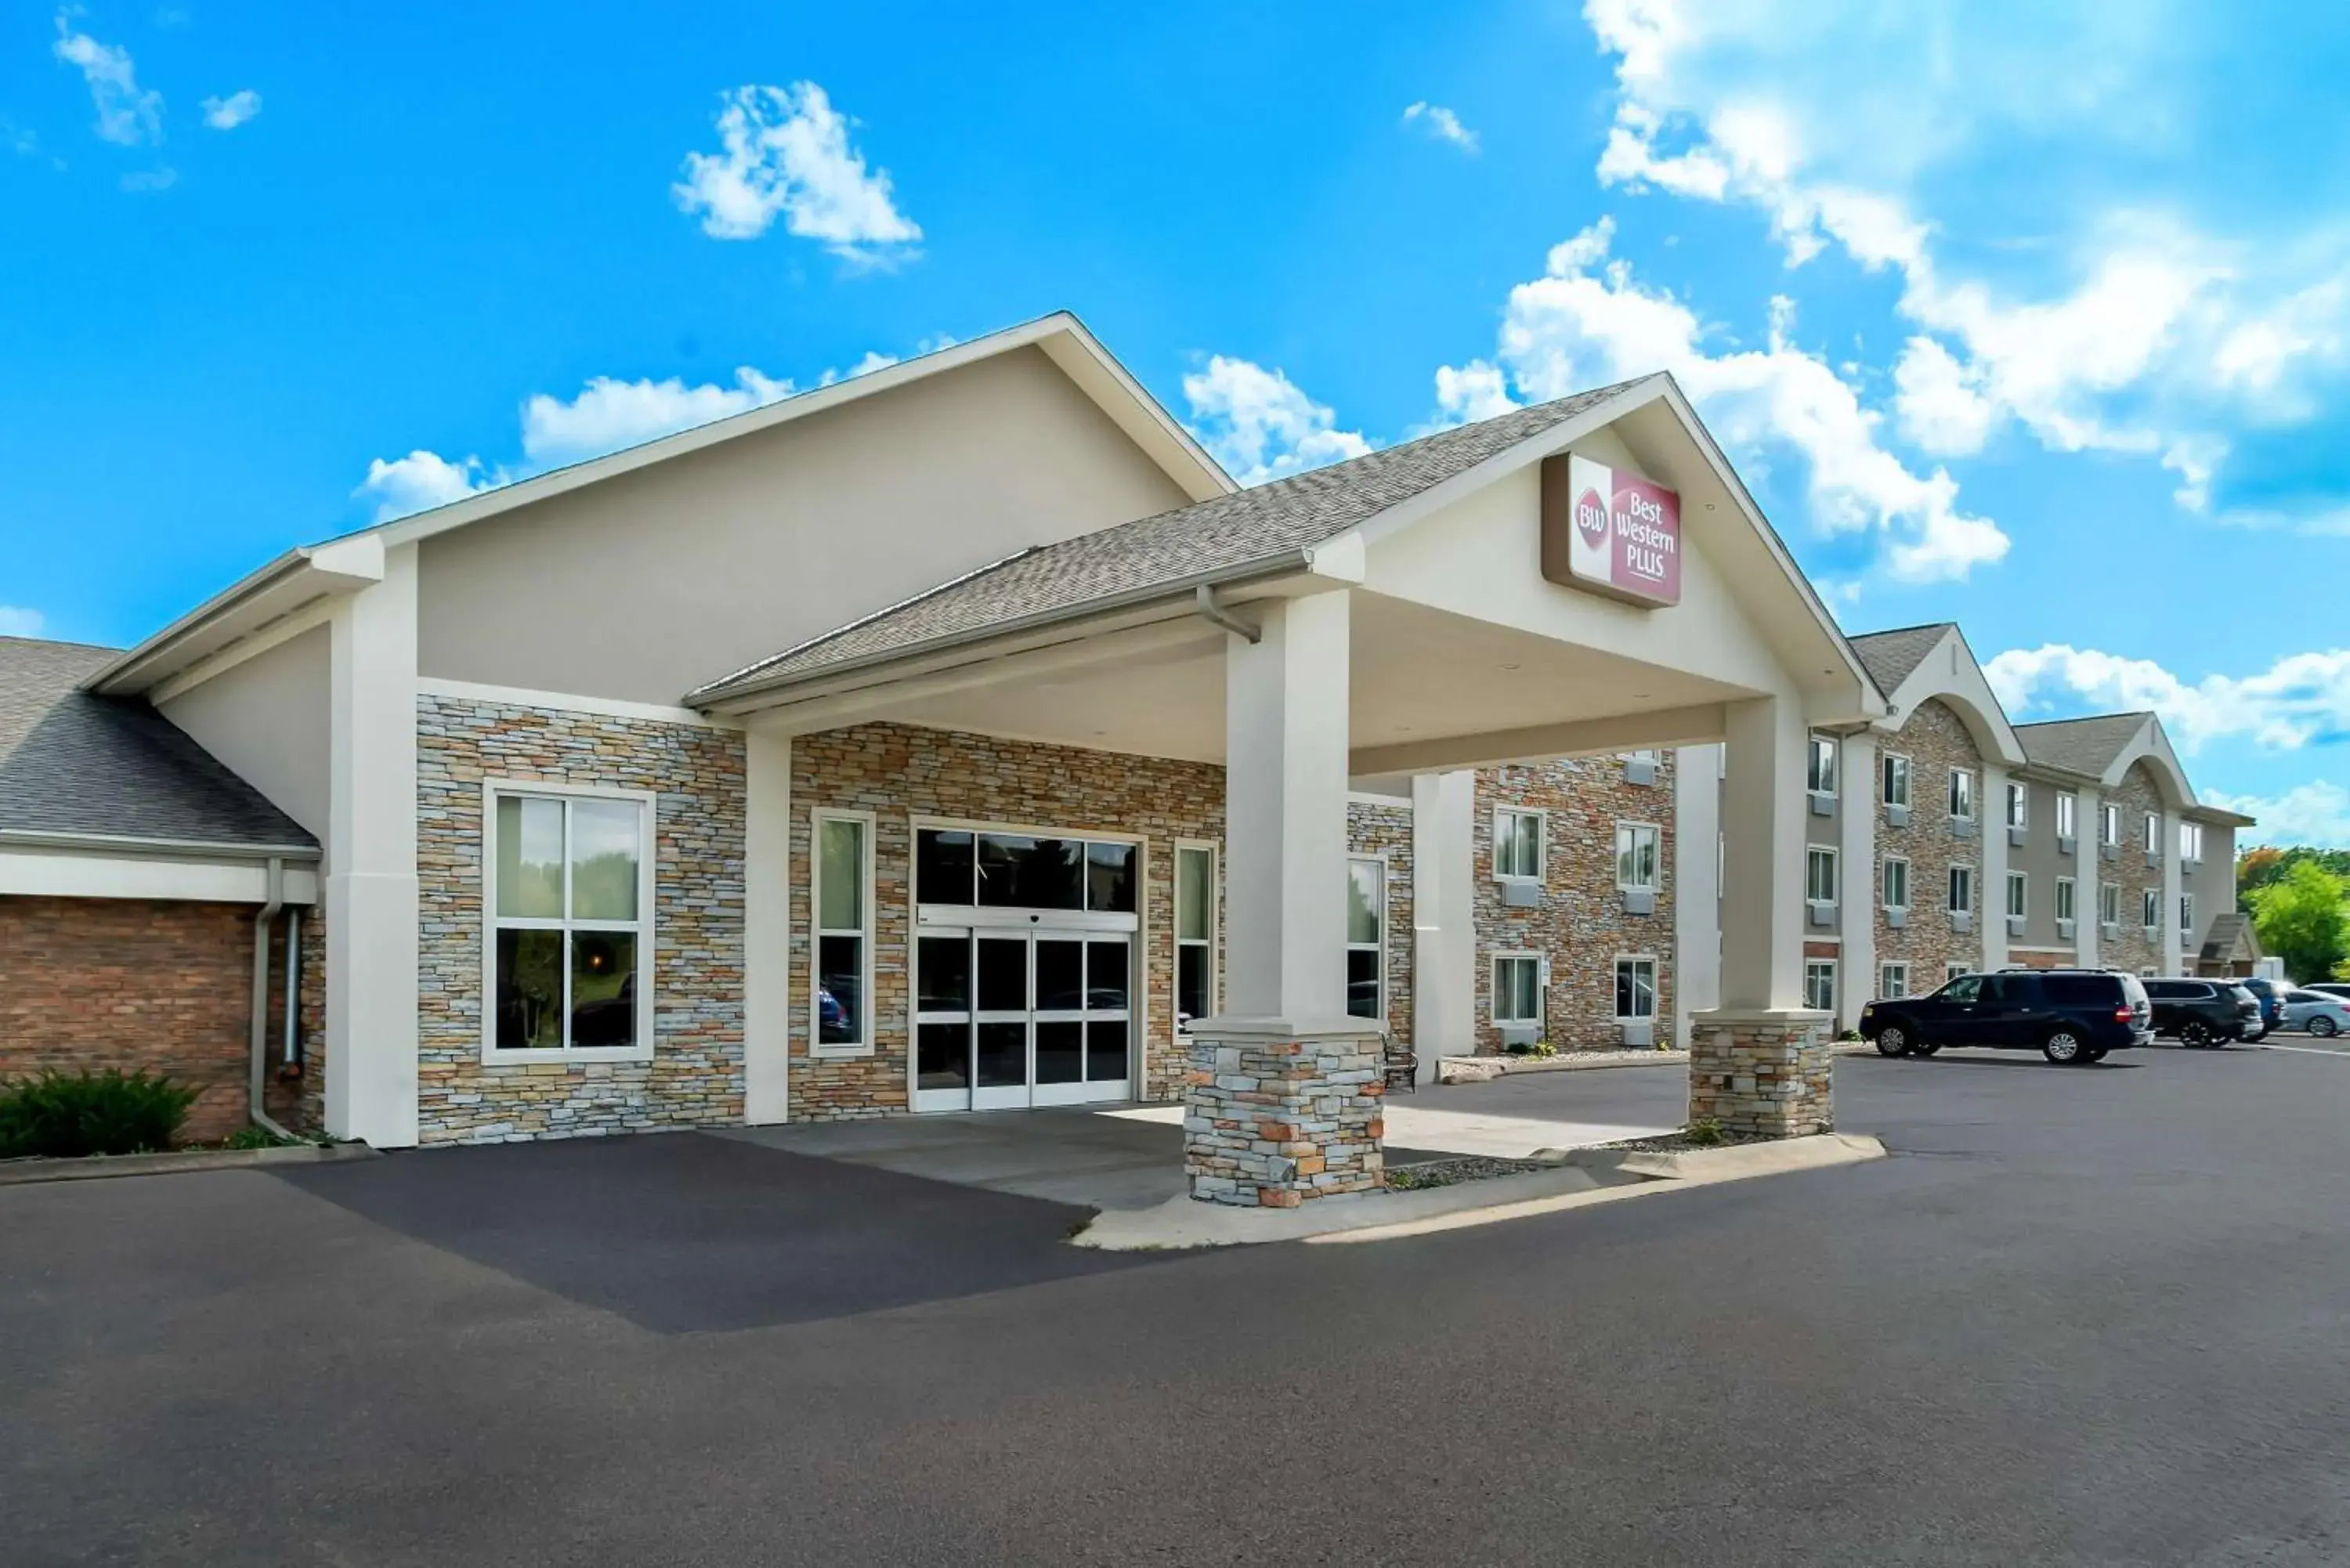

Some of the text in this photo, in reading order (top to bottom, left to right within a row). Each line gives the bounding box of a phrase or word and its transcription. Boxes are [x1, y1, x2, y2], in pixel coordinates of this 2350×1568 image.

[1579, 504, 1604, 532] BW
[1630, 493, 1663, 525] Best
[1617, 512, 1674, 553] Western
[1627, 545, 1664, 576] PLUS
